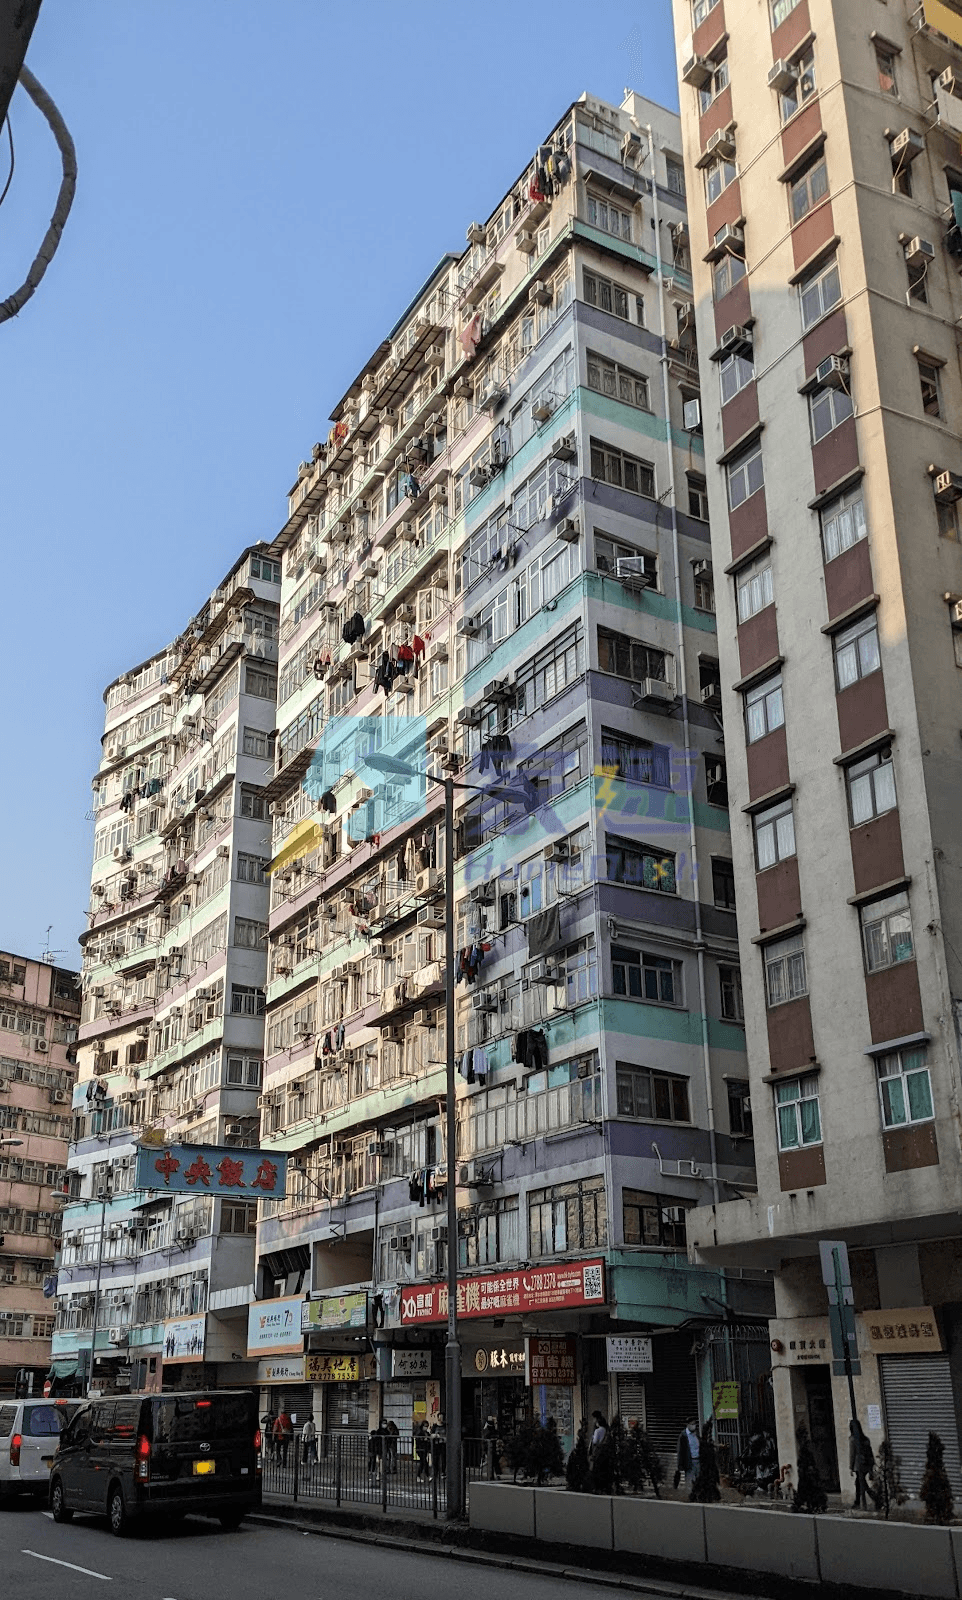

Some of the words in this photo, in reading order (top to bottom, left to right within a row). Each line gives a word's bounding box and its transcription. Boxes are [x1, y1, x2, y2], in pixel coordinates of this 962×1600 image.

[155, 1151, 278, 1190] 中央飯店
[480, 1277, 519, 1293] 可能係全世界
[530, 1275, 543, 1291] 2788
[543, 1272, 556, 1289] 2378
[416, 1293, 433, 1309] 宣和
[308, 1357, 357, 1373] 福美地產
[532, 1355, 574, 1368] 麻雀機
[539, 1368, 557, 1378] 2788
[557, 1368, 575, 1377] 2378
